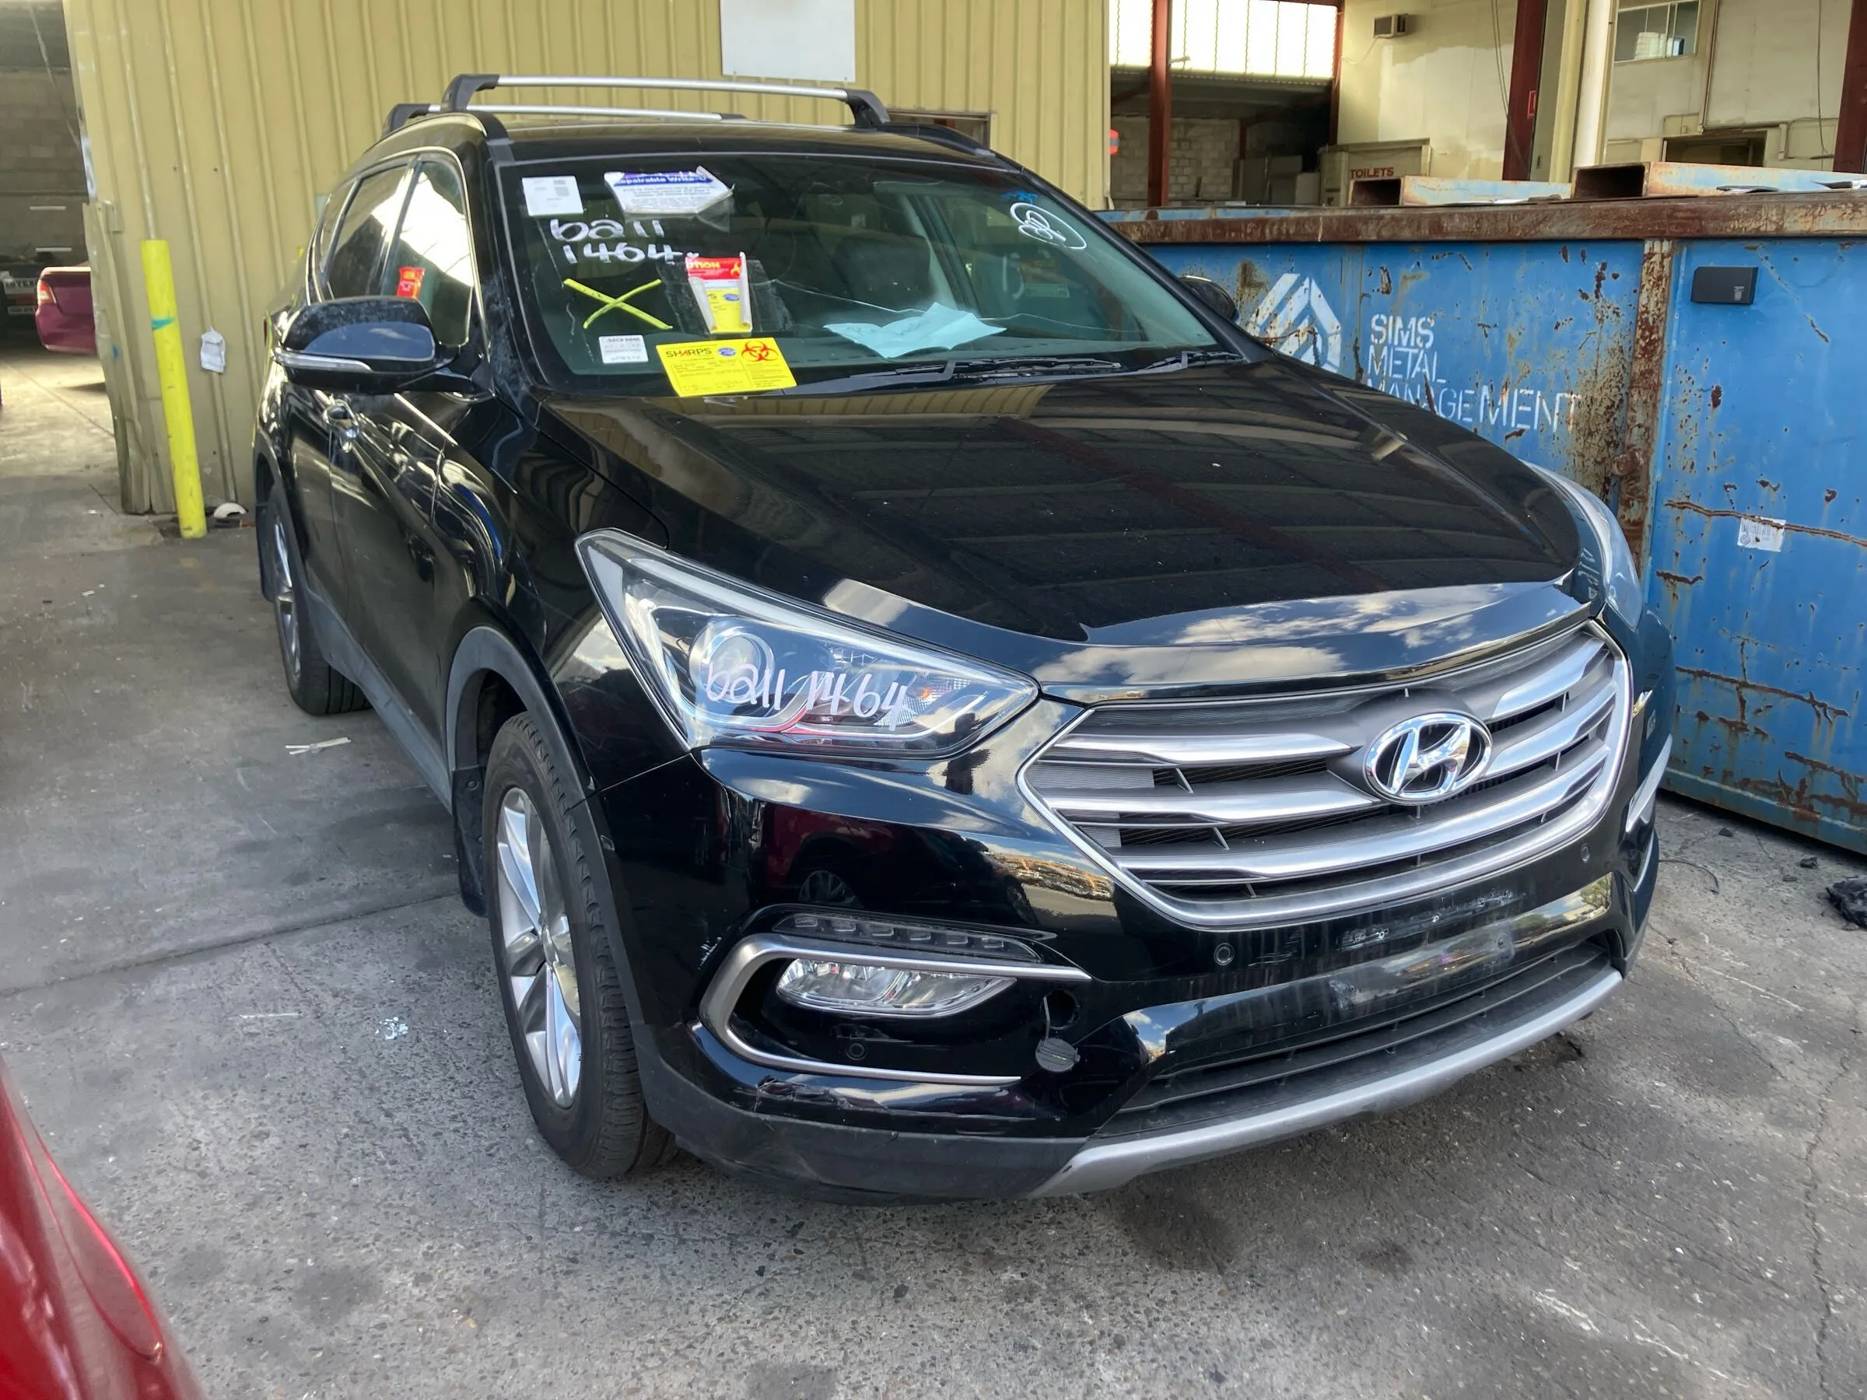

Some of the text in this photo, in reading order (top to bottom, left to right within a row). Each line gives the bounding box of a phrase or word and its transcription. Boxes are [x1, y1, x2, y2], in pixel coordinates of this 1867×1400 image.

[1350, 166, 1395, 179] TOILETS
[562, 241, 684, 265] 1464
[1370, 313, 1435, 349] SIMS
[665, 347, 713, 358] SHARPS
[1366, 345, 1447, 384] METAL
[1366, 378, 1582, 434] NAGEMENT
[806, 670, 909, 731] 1464
